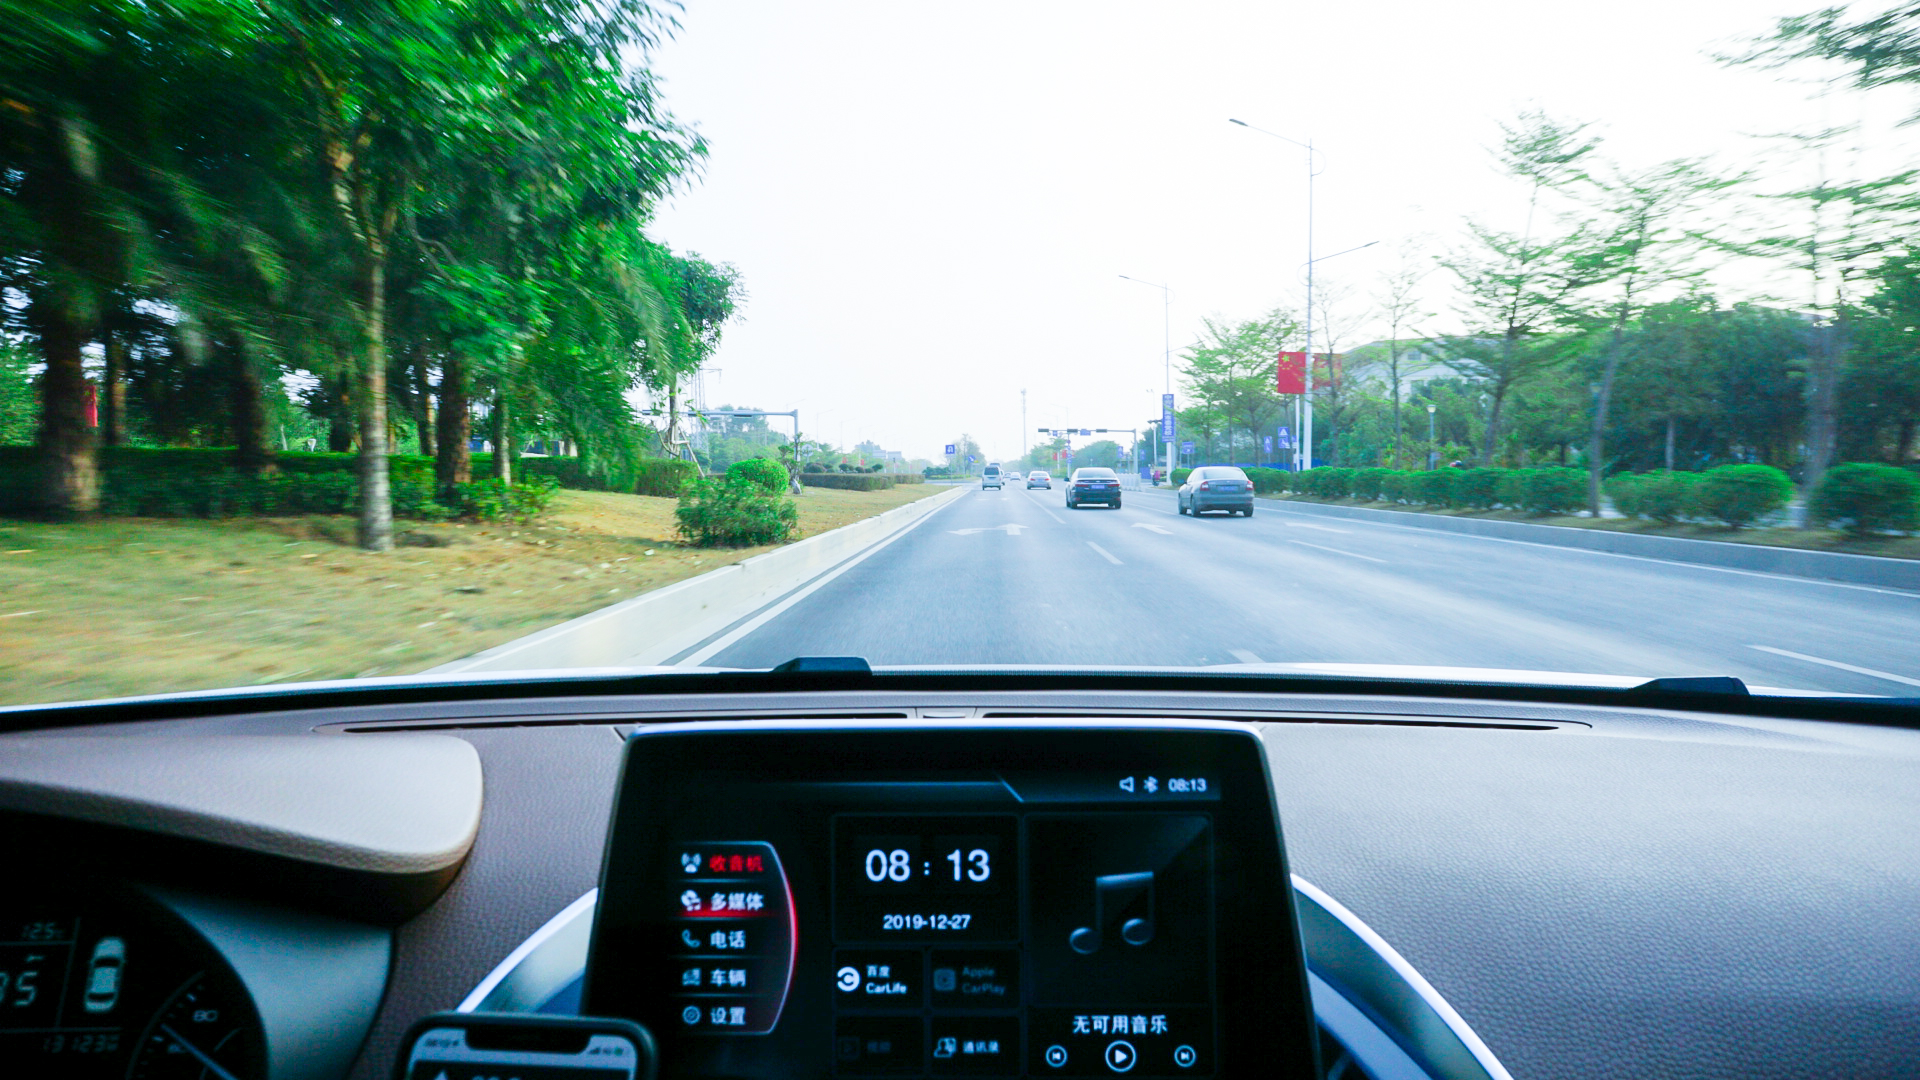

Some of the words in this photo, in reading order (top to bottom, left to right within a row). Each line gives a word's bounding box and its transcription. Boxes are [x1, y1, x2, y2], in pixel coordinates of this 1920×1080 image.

[1168, 777, 1207, 792] 08:13
[709, 854, 764, 872] 收音机
[711, 892, 764, 911] 多媒体
[882, 914, 971, 930] 2019-12-27
[710, 930, 746, 949] 电话
[710, 968, 747, 987] 车辆
[865, 982, 907, 995] CarLife
[710, 1006, 747, 1025] 设置
[1072, 1014, 1168, 1035] 无可用音乐
